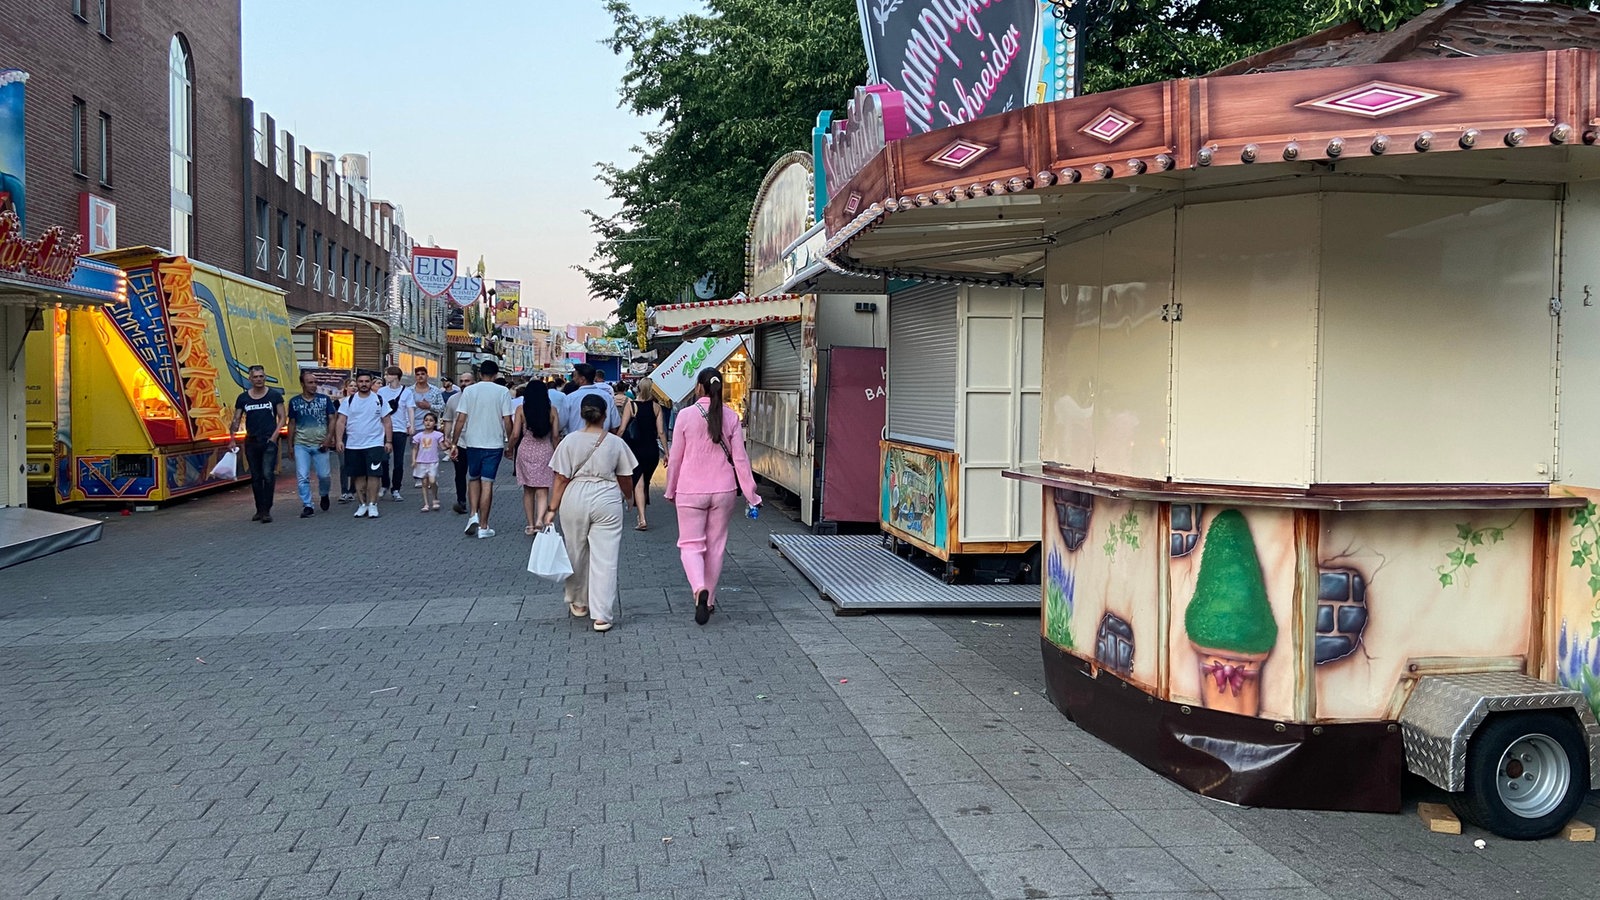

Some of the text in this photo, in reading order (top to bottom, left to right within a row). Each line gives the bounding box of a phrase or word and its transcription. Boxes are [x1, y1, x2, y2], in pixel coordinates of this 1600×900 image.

[938, 23, 1021, 127] Schneider
[416, 256, 454, 278] EIS
[417, 275, 452, 284] SCHMITZ
[451, 277, 480, 292] EIS
[104, 300, 158, 362] OMMES
[125, 273, 178, 392] BELGISCHE
[660, 353, 688, 380] Popcorn
[864, 385, 887, 401] BA
